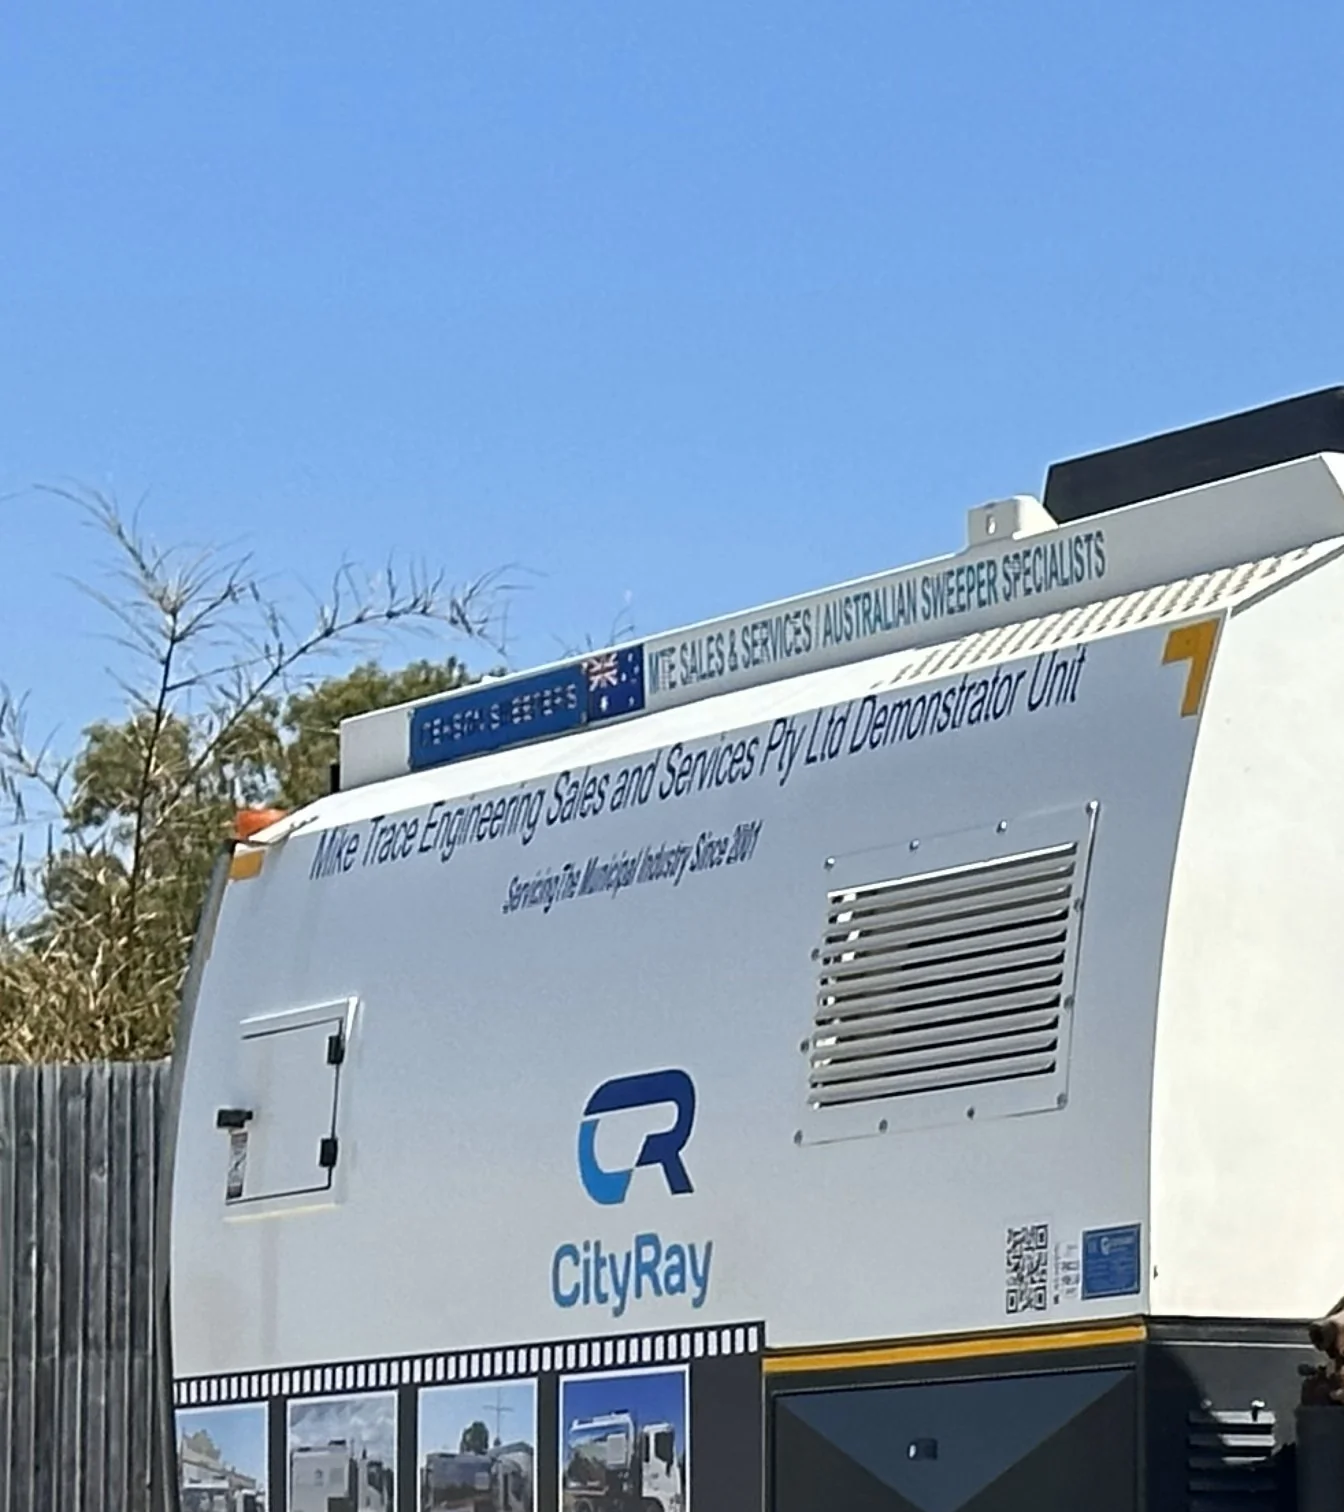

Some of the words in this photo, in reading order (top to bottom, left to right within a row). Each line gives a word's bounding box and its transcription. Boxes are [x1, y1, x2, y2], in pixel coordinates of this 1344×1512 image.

[648, 645, 677, 693] MTE
[680, 631, 725, 686] SALES
[727, 628, 739, 673] &
[741, 606, 812, 669] SERVICES
[822, 575, 917, 649] AUSTRALIAN
[921, 559, 998, 621] SWEEPER
[1002, 530, 1106, 602] SPECIALISTS
[309, 828, 360, 881] Mike
[362, 814, 419, 868] Trace
[419, 783, 546, 864] Engineering
[546, 765, 610, 826] Sales
[610, 750, 662, 813] and
[659, 732, 760, 800] Services
[760, 716, 806, 787] Pty
[804, 699, 854, 765] Ltd
[848, 666, 1026, 754] Demonstrator
[1028, 642, 1087, 712] Unit
[556, 862, 581, 902] The
[688, 830, 729, 873] Since
[577, 1068, 696, 1205] CR
[552, 1231, 713, 1318] CityRay
